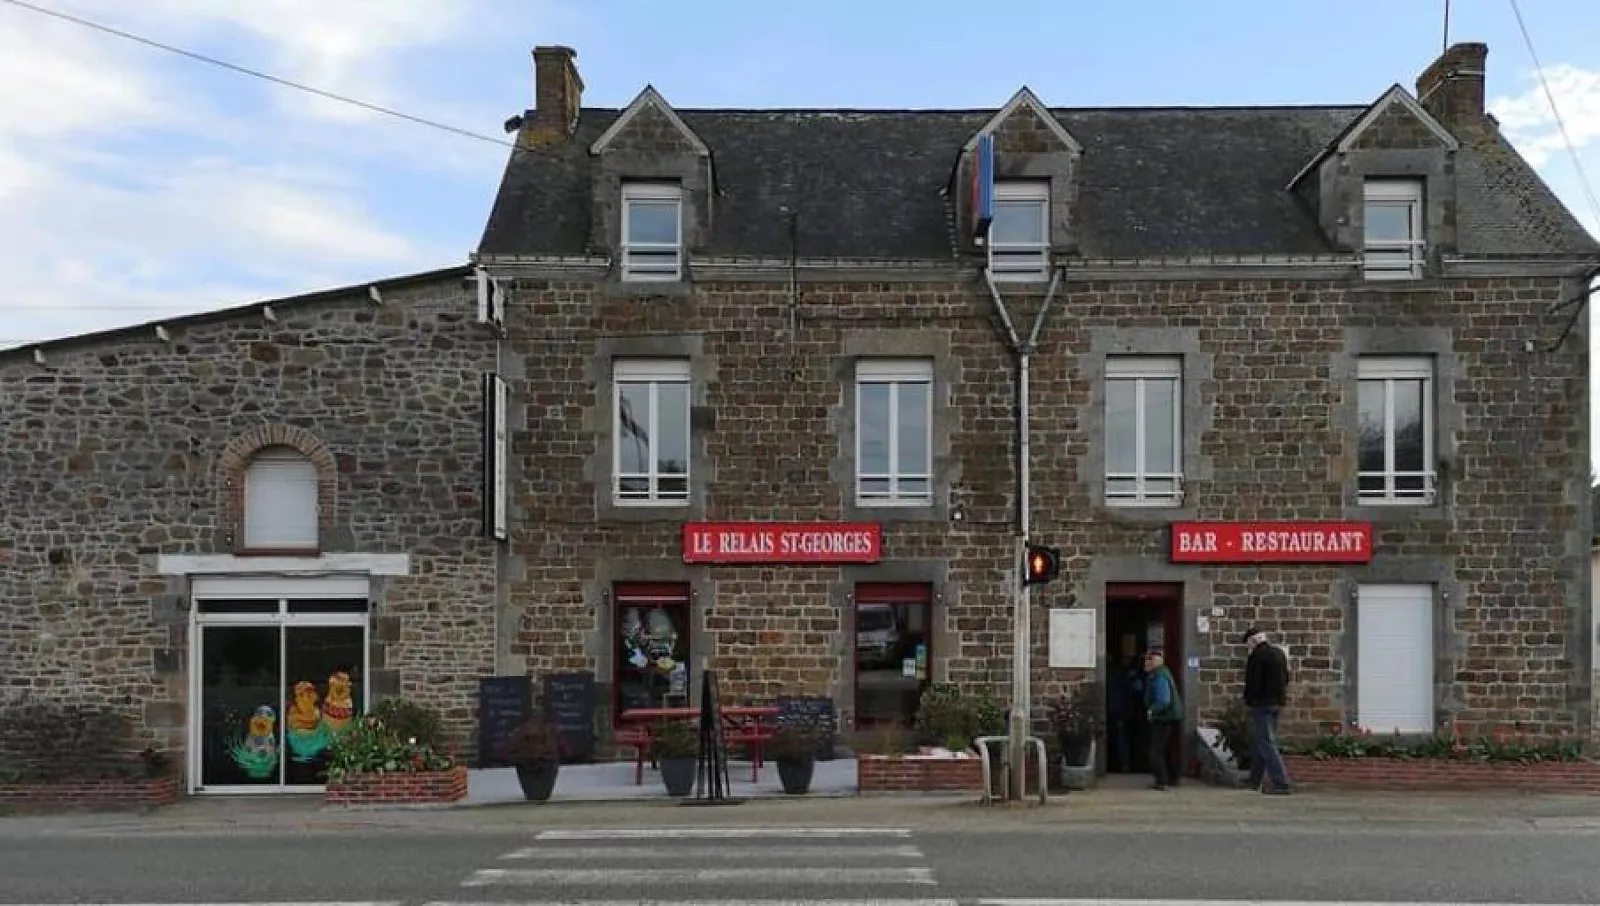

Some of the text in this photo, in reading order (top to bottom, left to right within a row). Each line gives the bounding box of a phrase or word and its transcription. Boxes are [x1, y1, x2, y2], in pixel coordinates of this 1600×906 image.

[693, 532, 712, 553] LE
[719, 532, 775, 553] RELAIS
[1179, 532, 1218, 553] BAR
[1241, 532, 1364, 553] RESTAURANT
